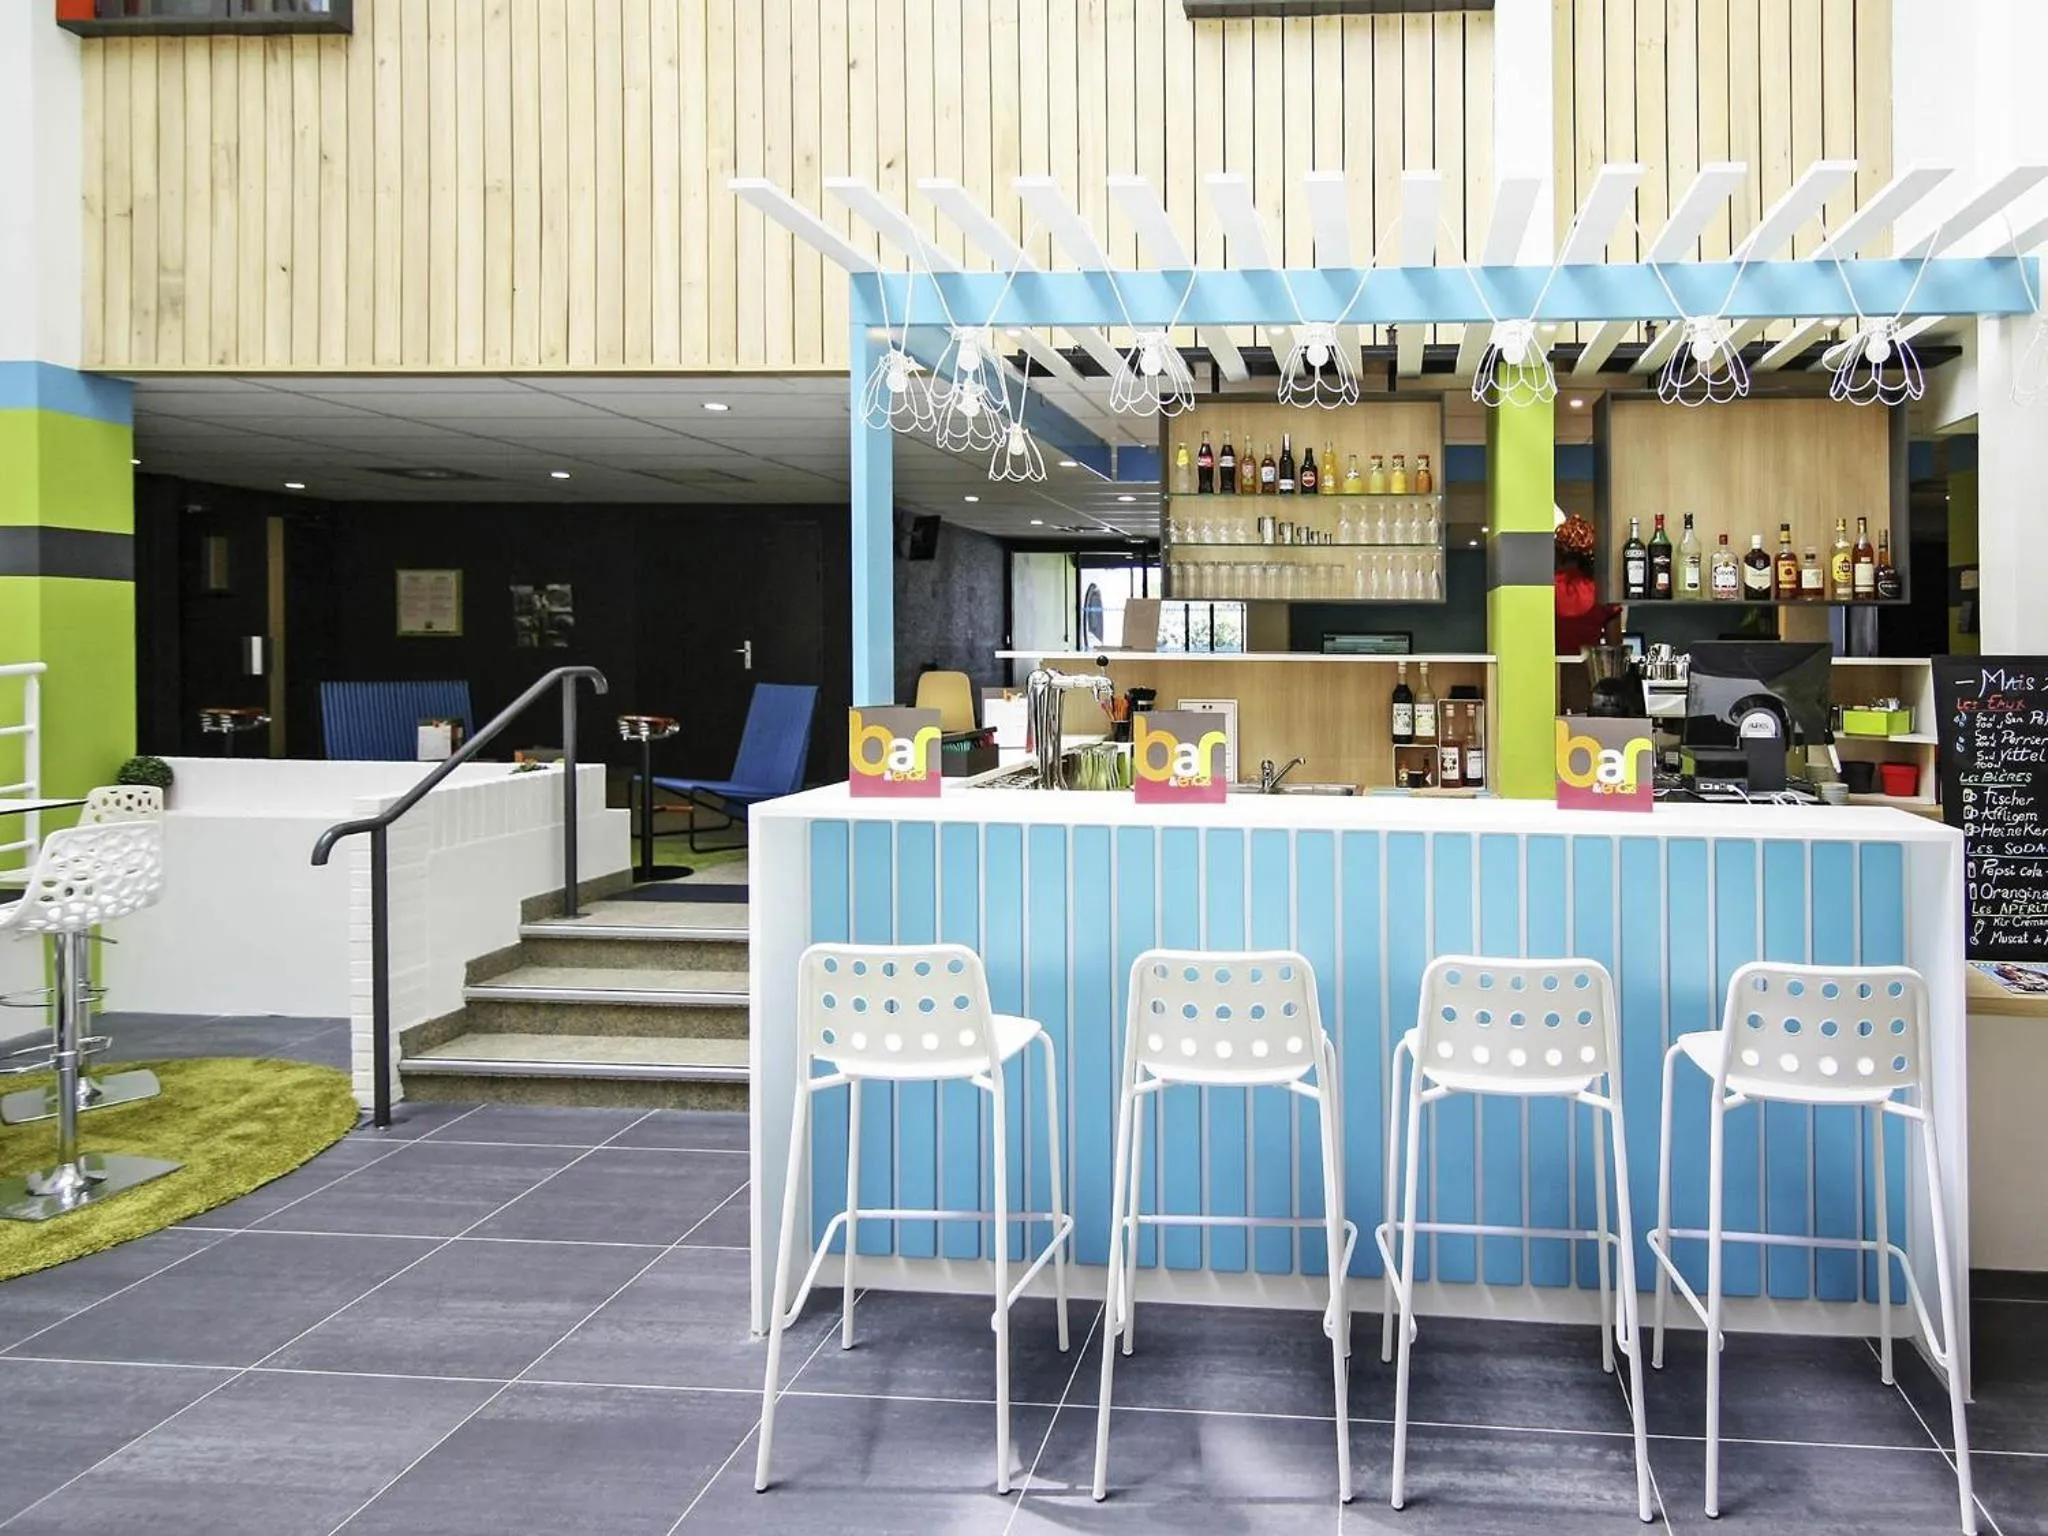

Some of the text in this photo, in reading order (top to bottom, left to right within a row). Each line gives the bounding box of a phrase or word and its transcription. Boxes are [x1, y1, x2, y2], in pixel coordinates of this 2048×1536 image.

[849, 710, 942, 777] bar
[1134, 714, 1226, 782] bar
[1556, 719, 1652, 788] bar
